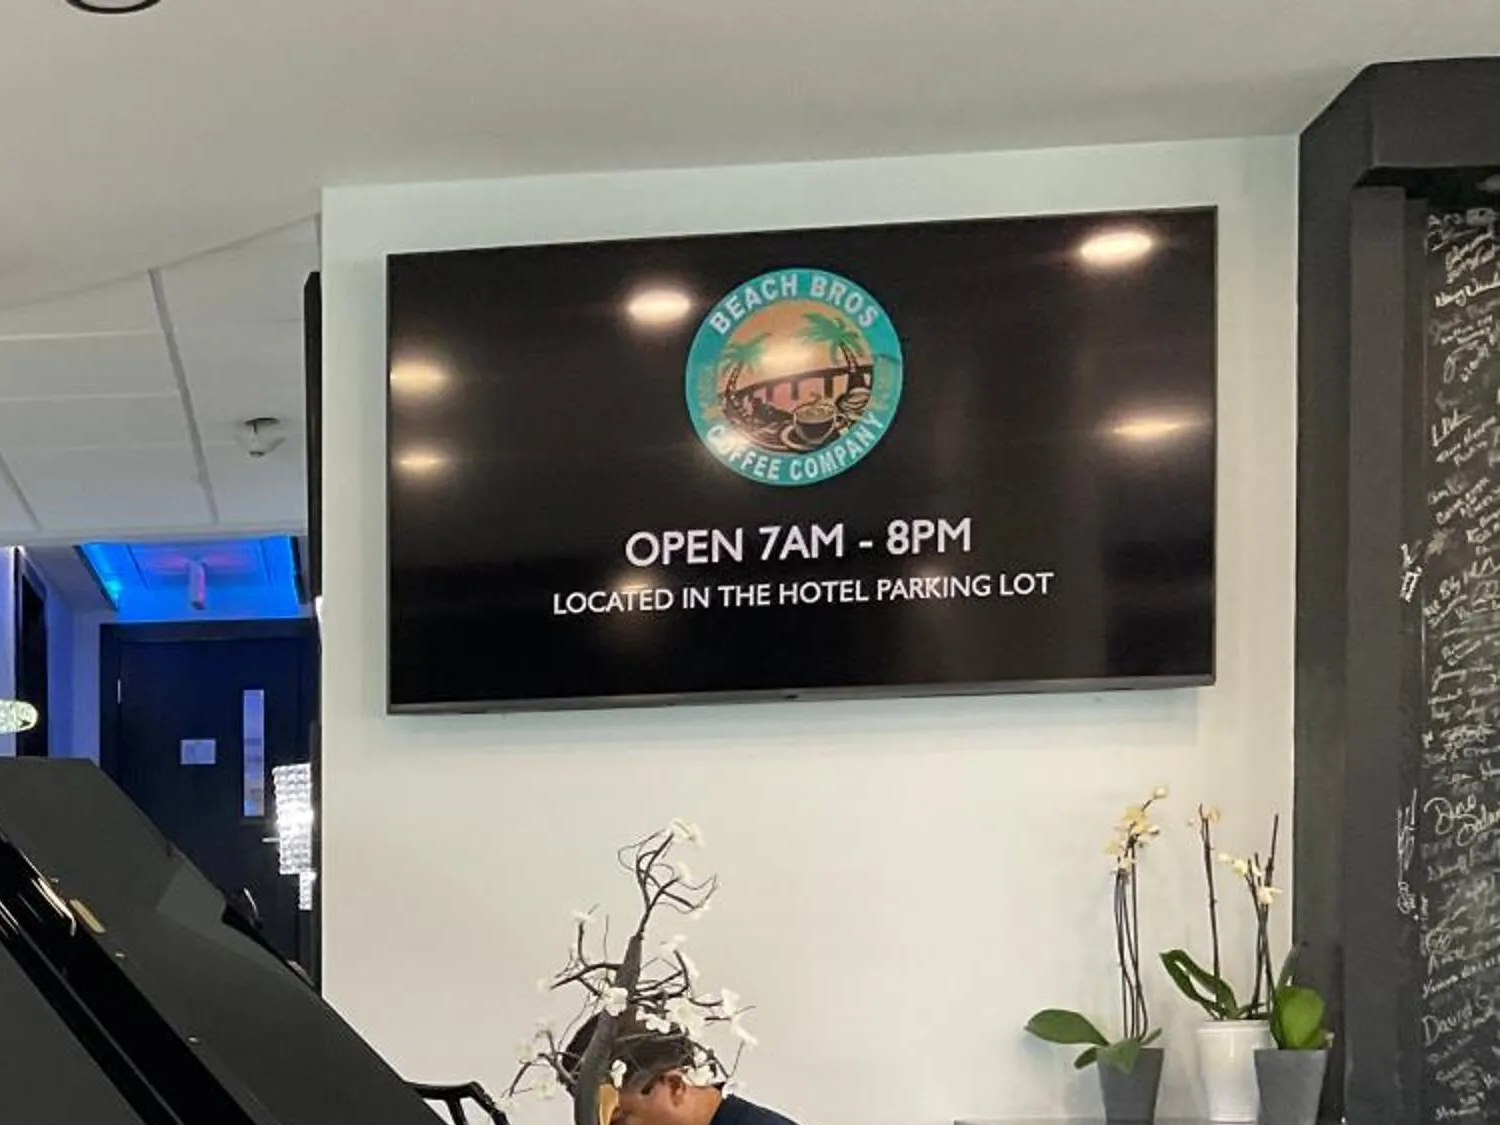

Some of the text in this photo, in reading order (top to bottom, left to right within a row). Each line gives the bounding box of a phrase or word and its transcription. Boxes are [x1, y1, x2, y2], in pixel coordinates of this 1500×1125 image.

[708, 273, 880, 335] BEACH BROS
[789, 411, 885, 481] COMPANY
[625, 527, 743, 567] OPEN
[758, 523, 845, 561] 7AM
[886, 517, 972, 555] 8PM
[552, 571, 1055, 615] LOCATED IN THE HOTEL PARKING LOT
